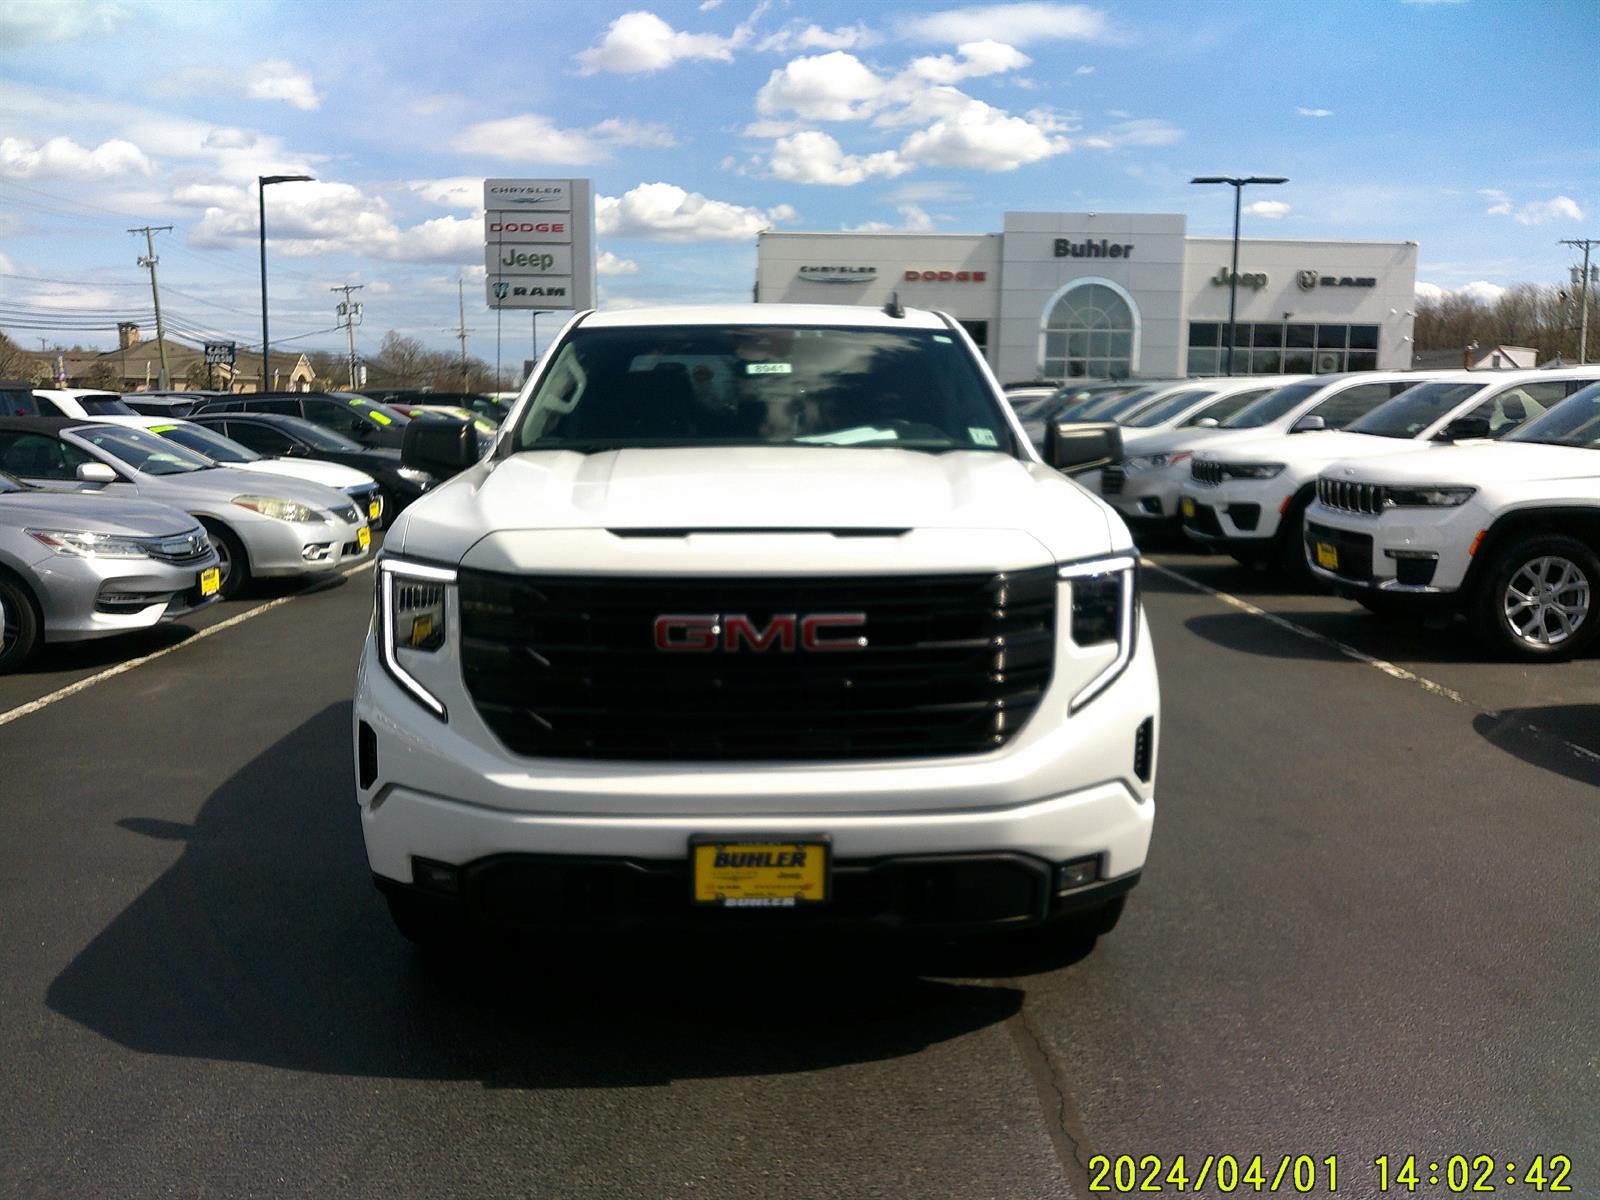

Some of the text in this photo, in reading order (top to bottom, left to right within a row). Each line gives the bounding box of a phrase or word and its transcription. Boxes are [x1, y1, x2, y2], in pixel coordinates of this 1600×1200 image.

[489, 223, 564, 233] DODGE
[1053, 238, 1135, 260] Buhler
[502, 249, 554, 271] Jeep
[799, 266, 877, 274] CHRYSLER
[904, 270, 987, 282] DODGE
[1320, 276, 1377, 288] RAM
[513, 287, 566, 297] RAM
[654, 613, 868, 651] GMC
[714, 851, 807, 868] BUHLER
